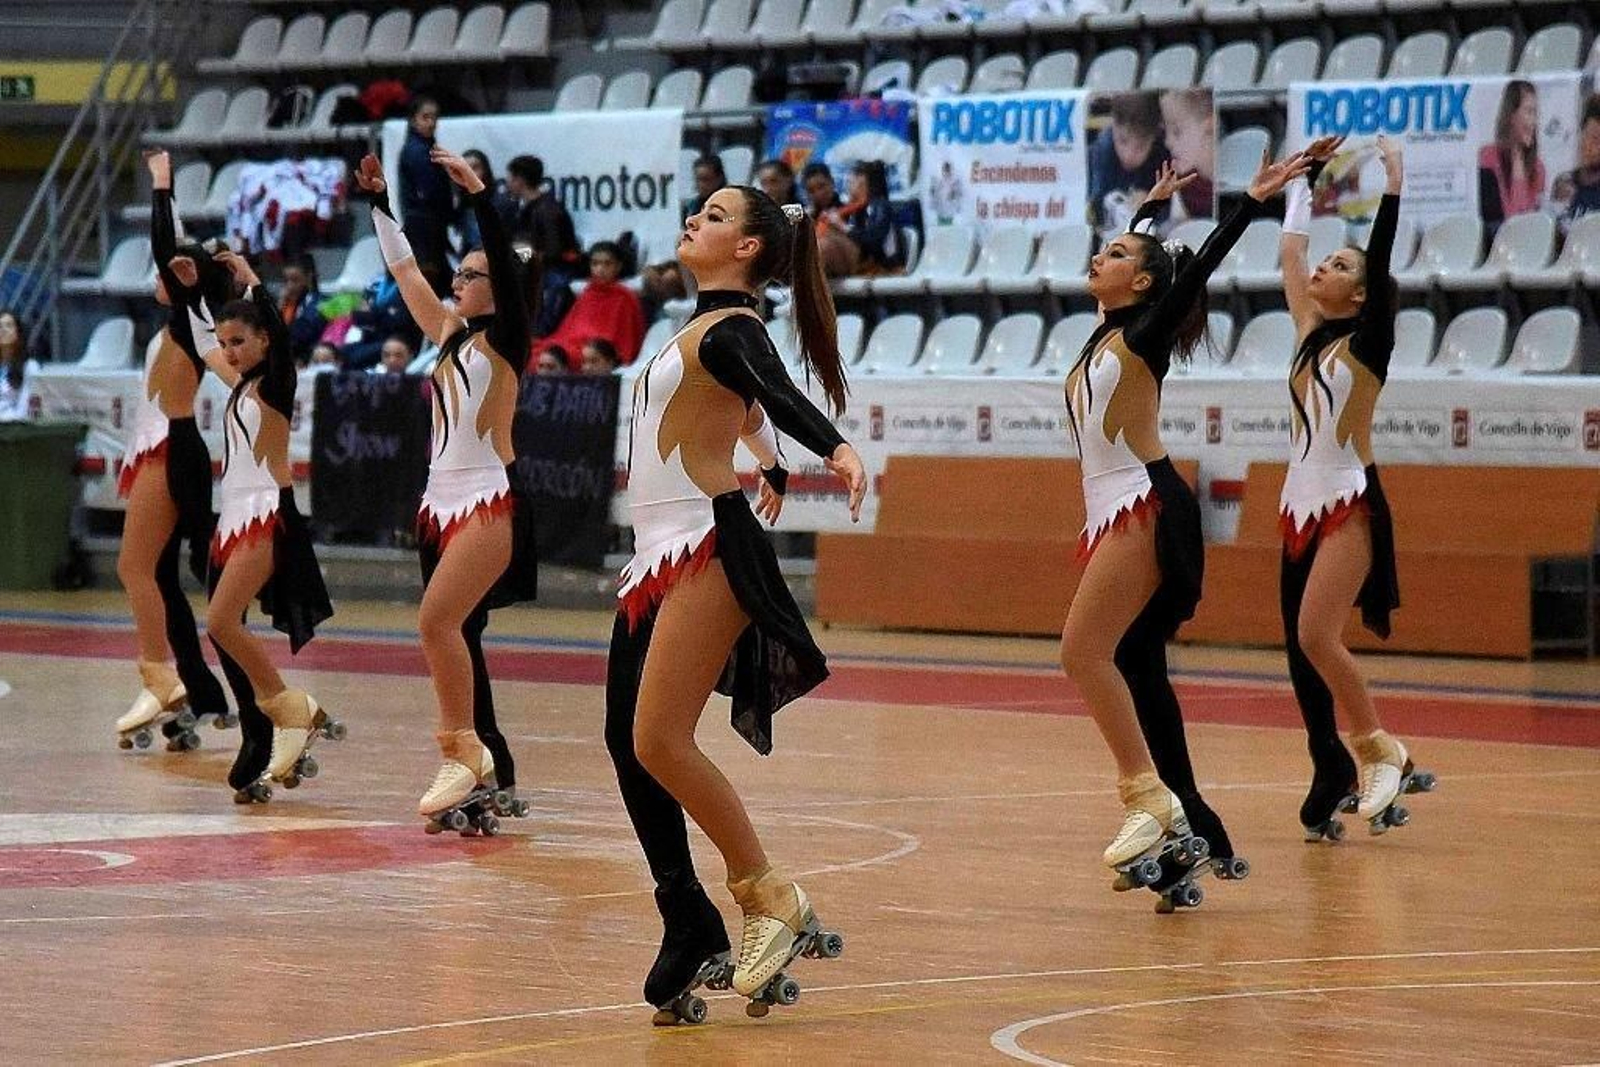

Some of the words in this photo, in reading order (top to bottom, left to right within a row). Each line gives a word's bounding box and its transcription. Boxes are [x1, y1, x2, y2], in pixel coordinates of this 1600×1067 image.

[1305, 84, 1470, 136] ROBOTIX
[931, 99, 1076, 144] ROBOTIX
[1173, 416, 1196, 435] Vigo
[1416, 419, 1440, 438] Vigo
[1479, 419, 1527, 436] Concello
